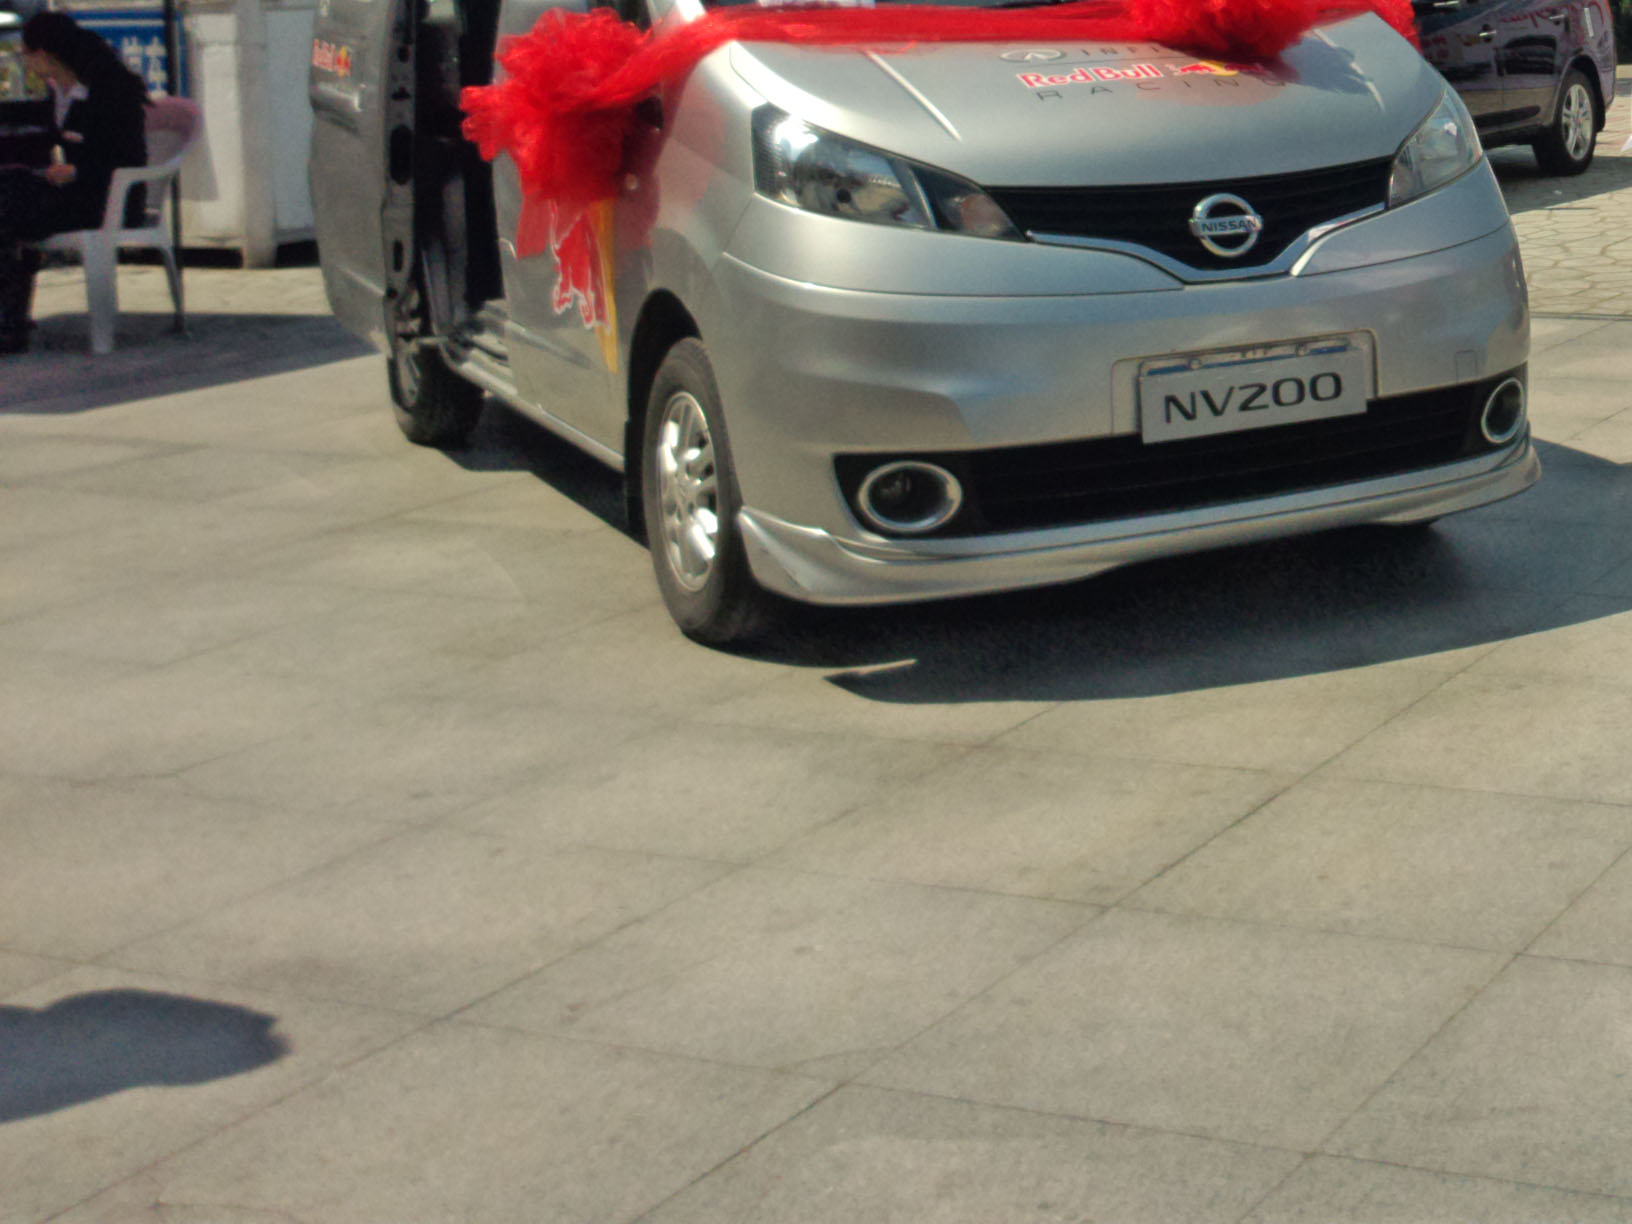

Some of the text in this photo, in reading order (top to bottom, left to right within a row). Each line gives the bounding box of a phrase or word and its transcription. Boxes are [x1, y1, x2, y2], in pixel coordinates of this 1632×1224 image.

[1089, 62, 1165, 82] Bull
[1036, 78, 1287, 101] RACING
[1201, 217, 1258, 233] NISSAN
[1164, 371, 1343, 424] NV200
